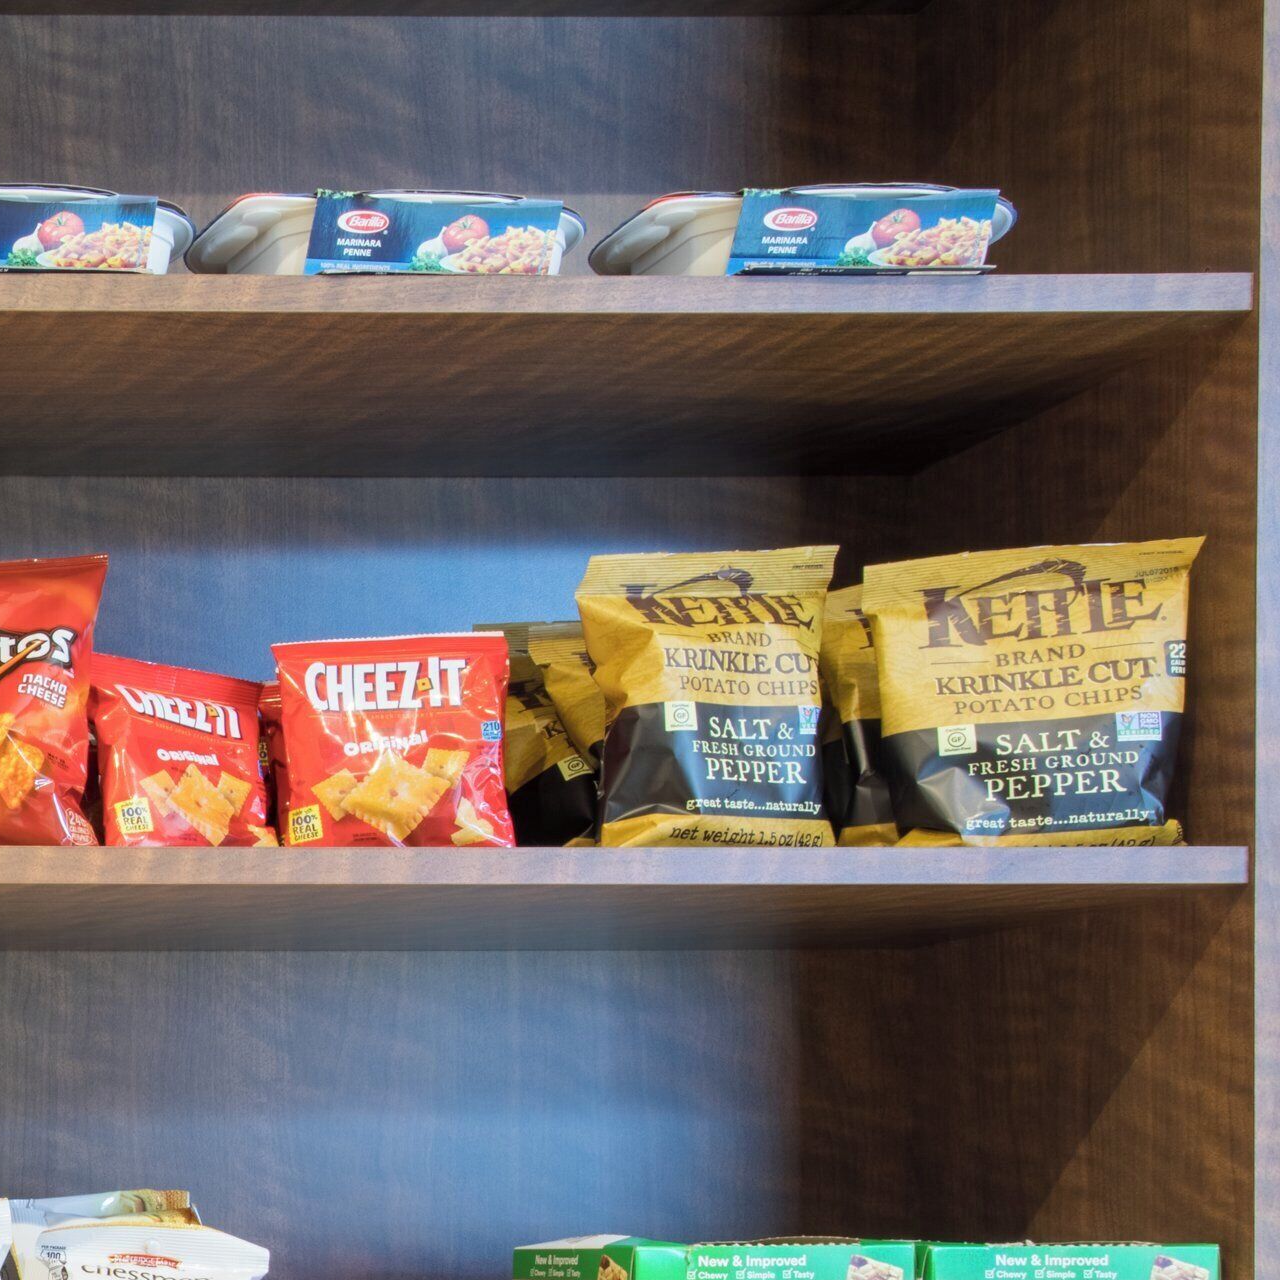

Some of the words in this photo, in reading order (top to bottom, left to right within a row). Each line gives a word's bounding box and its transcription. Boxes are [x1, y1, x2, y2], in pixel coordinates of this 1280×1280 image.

[914, 575, 1165, 650] KETTLE
[665, 647, 771, 675] KRINKLE
[996, 644, 1085, 668] BRAND
[23, 673, 67, 696] NACHO
[935, 665, 1085, 697] KRINKLE
[1088, 657, 1156, 684] CUT
[18, 683, 66, 708] CHEESE
[954, 695, 1055, 715] POTATO
[1064, 686, 1143, 706] CHIPS
[710, 717, 770, 740] SALT
[778, 723, 793, 740] &
[692, 741, 739, 756] FRESH
[743, 743, 816, 757] GROUND
[996, 729, 1081, 756] SALT
[1089, 731, 1110, 748] &
[705, 757, 807, 784] PEPPER
[968, 758, 1037, 776] FRESH
[1045, 751, 1138, 769] GROUND
[984, 769, 1127, 802] PEPPER
[291, 814, 318, 826] 100%
[292, 825, 317, 836] REAL
[966, 817, 1005, 831] great
[670, 826, 698, 840] net
[703, 827, 755, 845] weight
[698, 1255, 730, 1267] New
[733, 1255, 743, 1267] &
[746, 1255, 807, 1270] Improved
